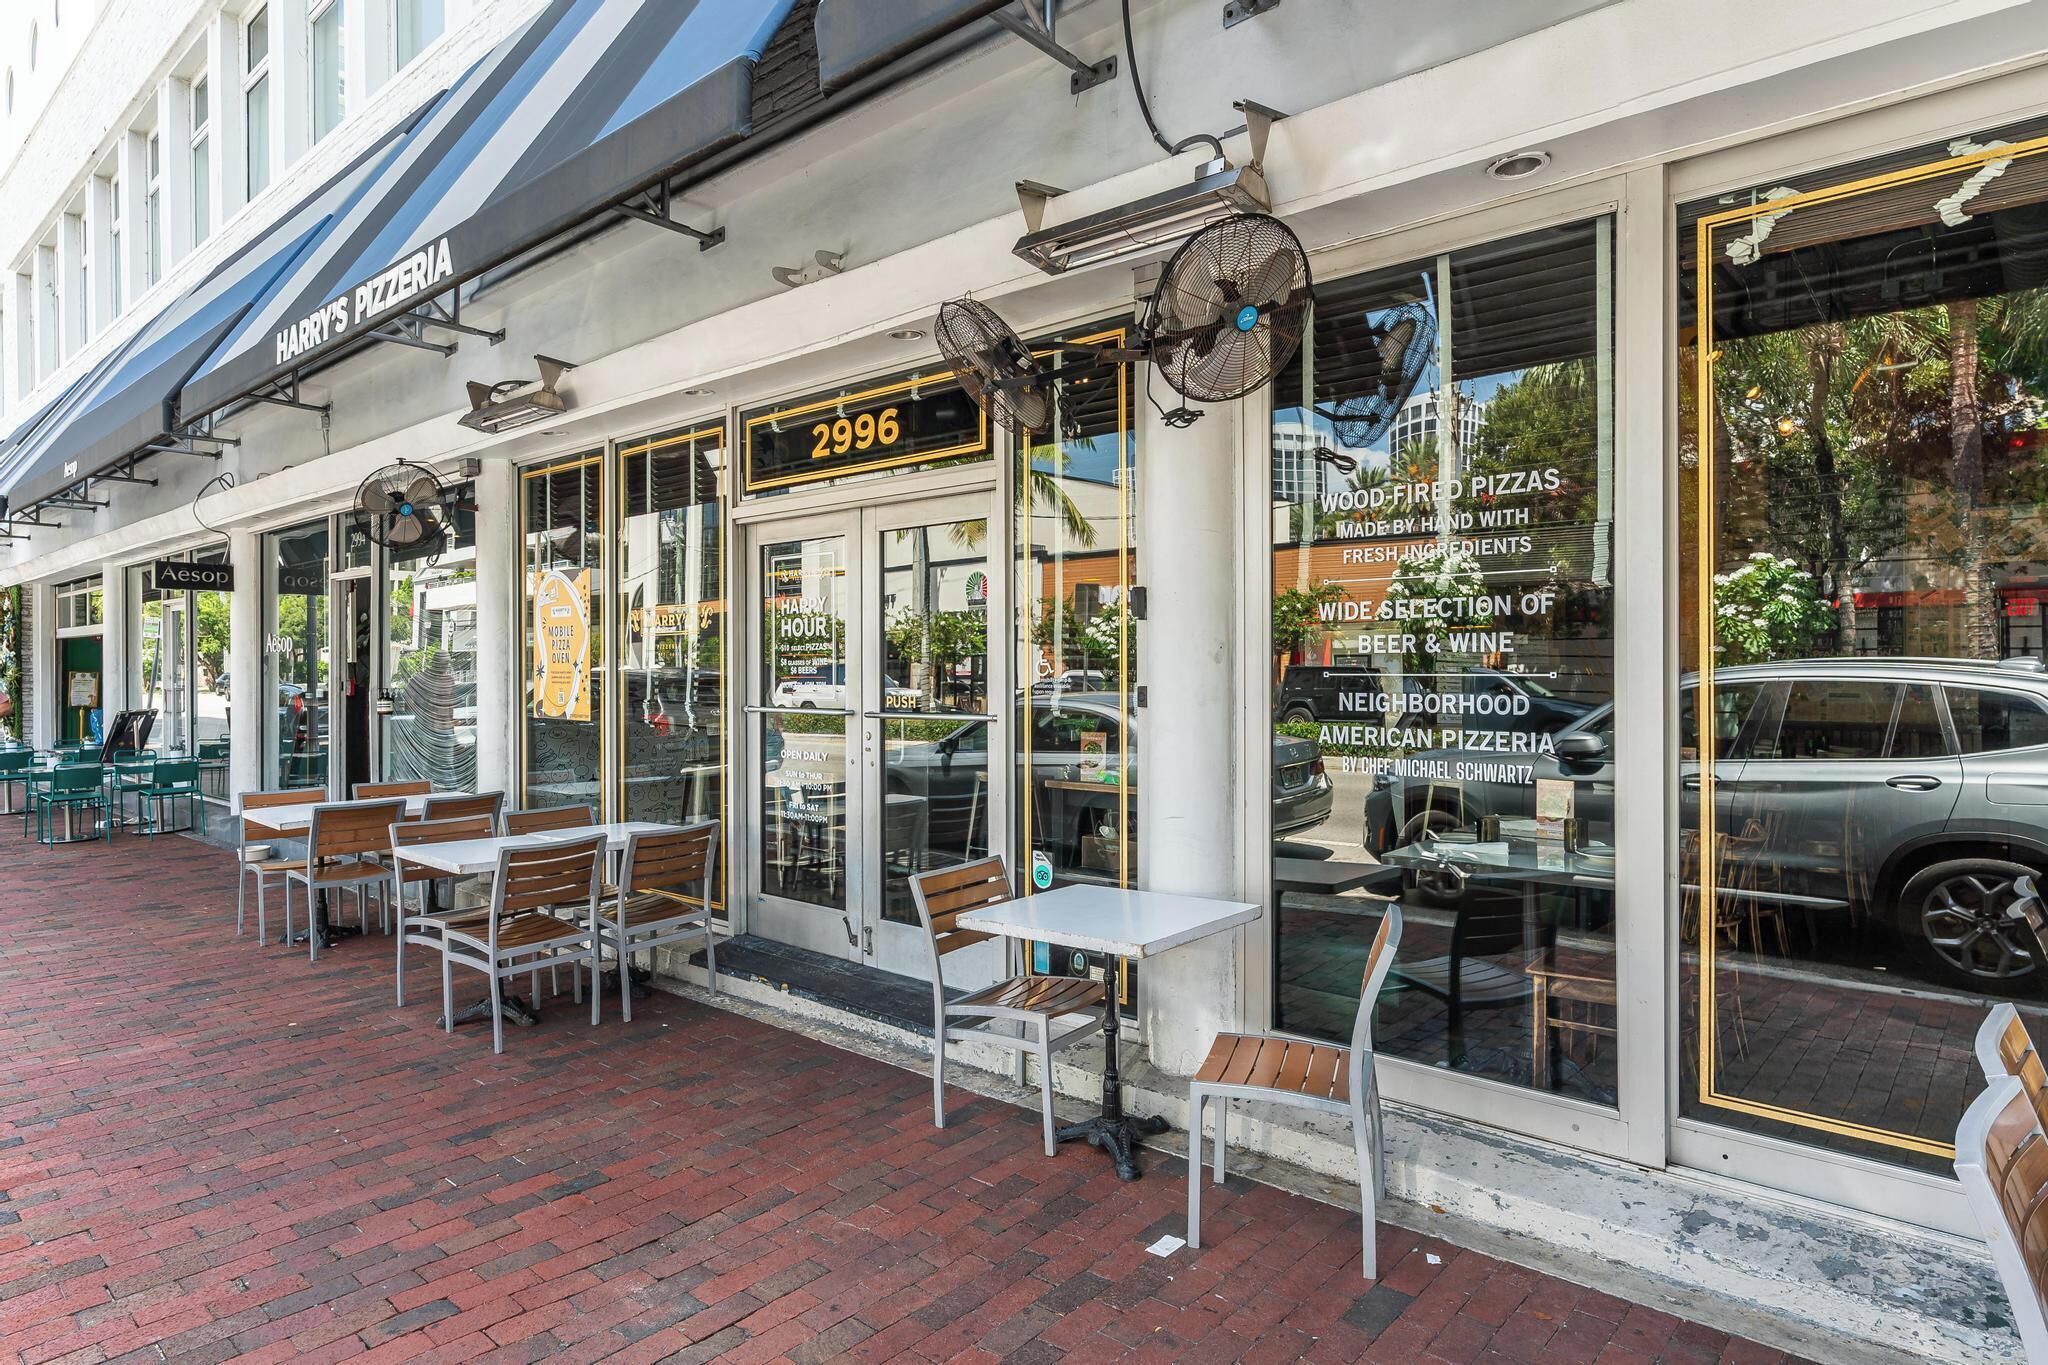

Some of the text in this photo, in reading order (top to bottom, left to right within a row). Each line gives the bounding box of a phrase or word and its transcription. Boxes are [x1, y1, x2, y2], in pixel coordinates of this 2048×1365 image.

[276, 237, 454, 365] HARRY'S PIZZERIA
[811, 408, 899, 458] 2996
[1320, 468, 1561, 513] WOOD-FIRED PIZZAS
[1339, 508, 1529, 539] MADE BY HAND WITH
[1343, 536, 1533, 564] FRESH INGREDIENTS
[781, 596, 828, 616] HAPPY
[1318, 593, 1555, 621] WIDE SELECTION OF
[548, 625, 574, 637] MOBILE
[781, 617, 827, 638] HOUR
[551, 640, 571, 651] PIZZA
[806, 642, 828, 651] PIZZAS
[1358, 632, 1514, 653] BEER & WINE
[551, 653, 571, 664] OVEN
[812, 656, 828, 666] WINE
[798, 666, 818, 674] BEERS
[886, 696, 916, 708] PUSH
[1338, 692, 1530, 716] NEIGHBORHOOD
[1318, 725, 1556, 754] AMERICAN PIZZERIA
[780, 749, 829, 761] OPEN DAILY
[785, 770, 823, 780] SUN to THUR
[1342, 757, 1533, 785] BY CHEF MICHAEL SCHWARTZ
[789, 801, 819, 812] FRI to SAT
